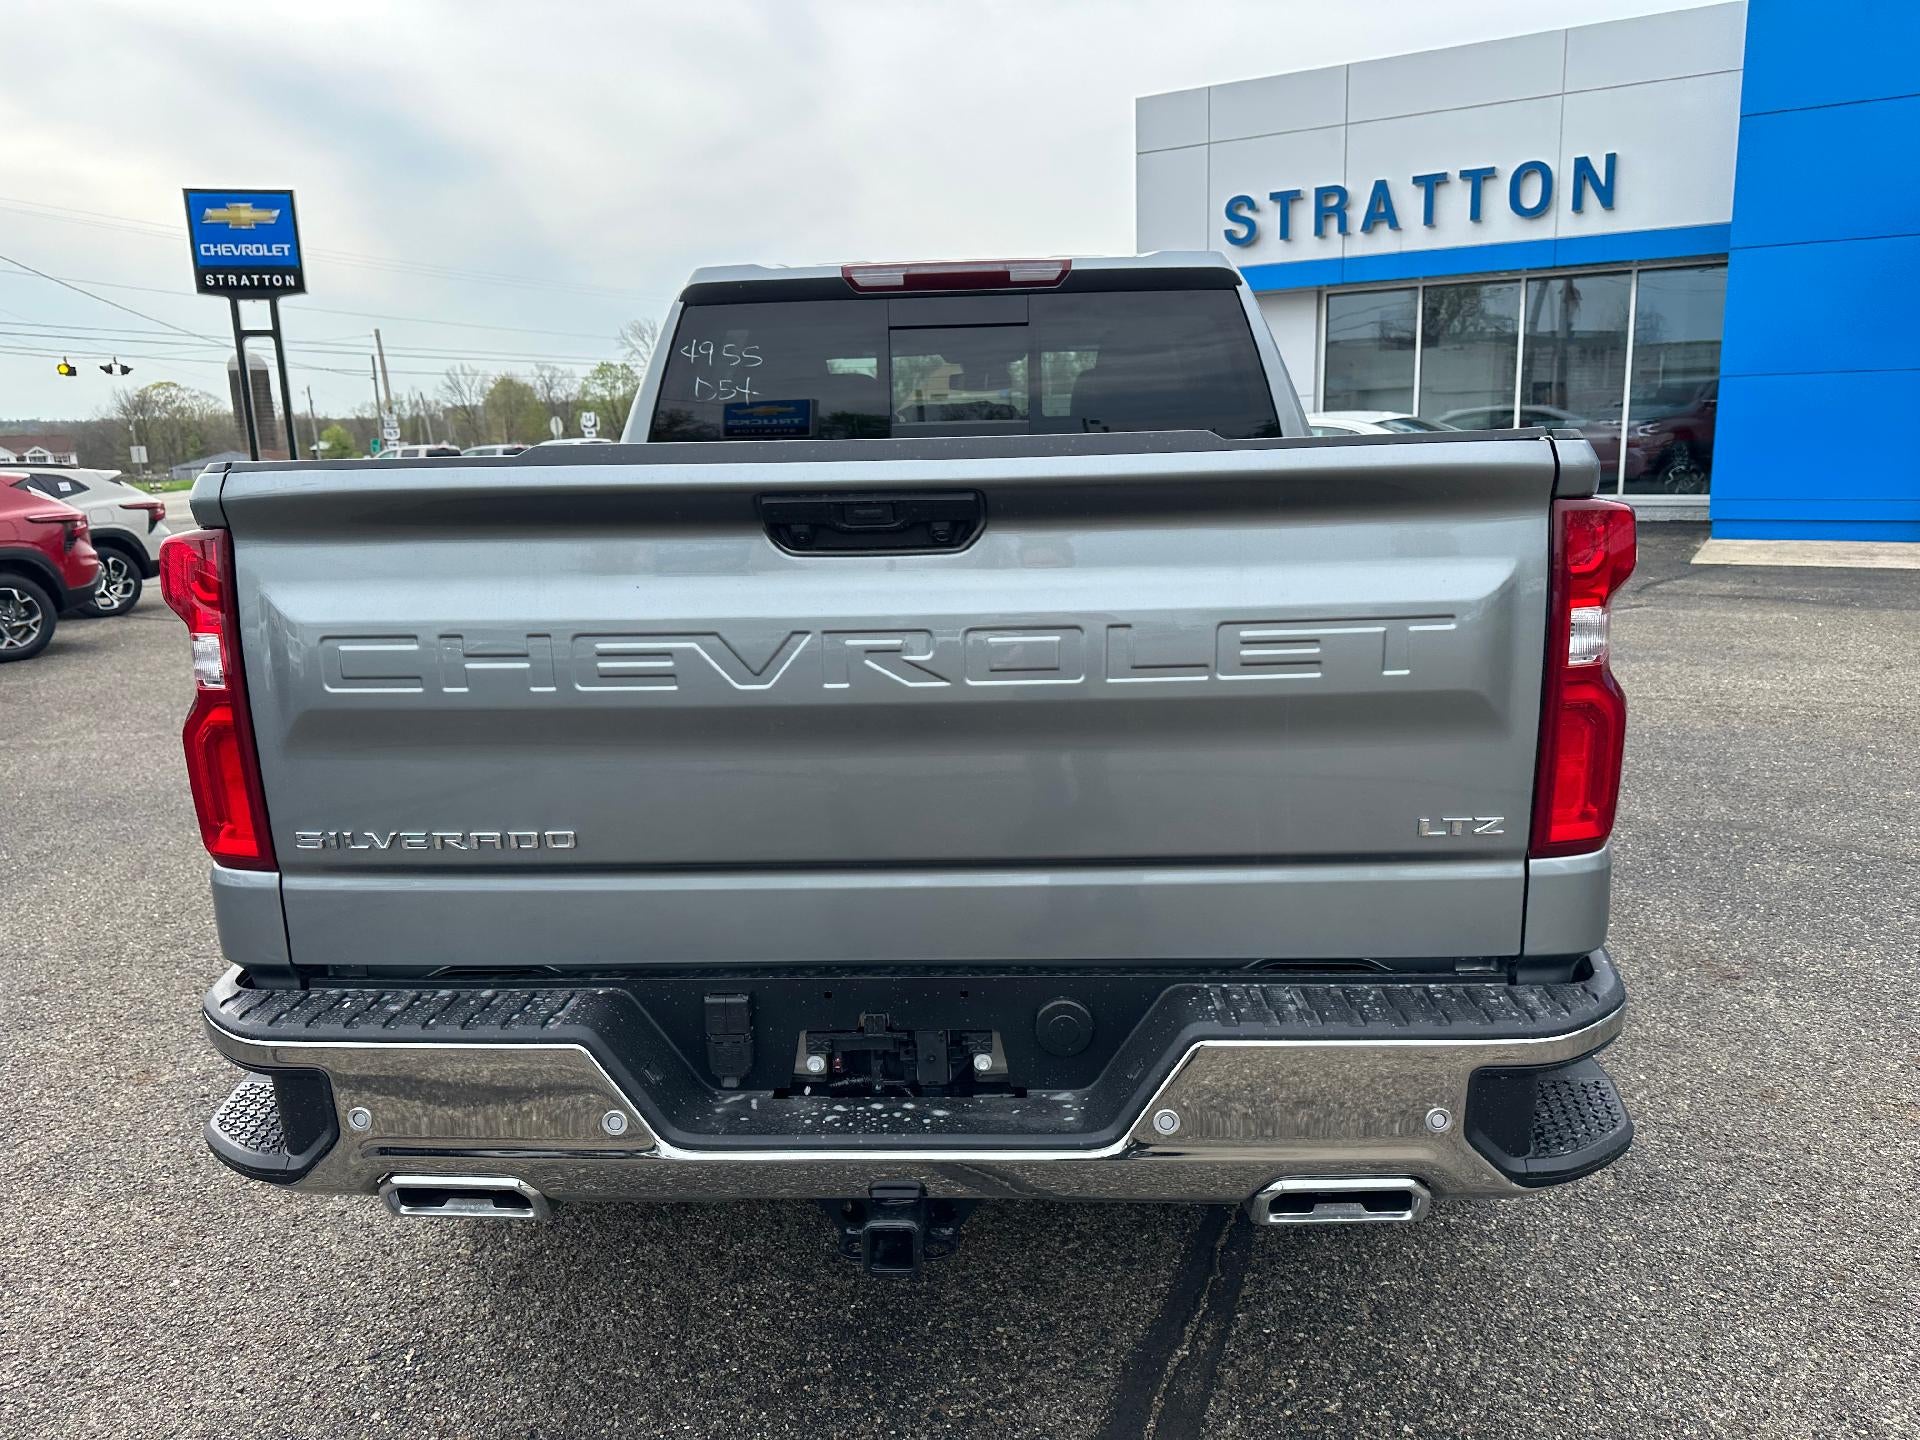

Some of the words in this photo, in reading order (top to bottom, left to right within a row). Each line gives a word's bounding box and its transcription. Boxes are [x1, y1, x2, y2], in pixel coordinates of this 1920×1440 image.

[1223, 152, 1617, 247] STRATTON
[200, 243, 290, 256] CHEVROLET
[205, 274, 295, 287] STRATTON
[320, 615, 1457, 693] CHEVROLET
[1418, 815, 1505, 836] LTZ
[295, 830, 577, 850] SILVERADO
